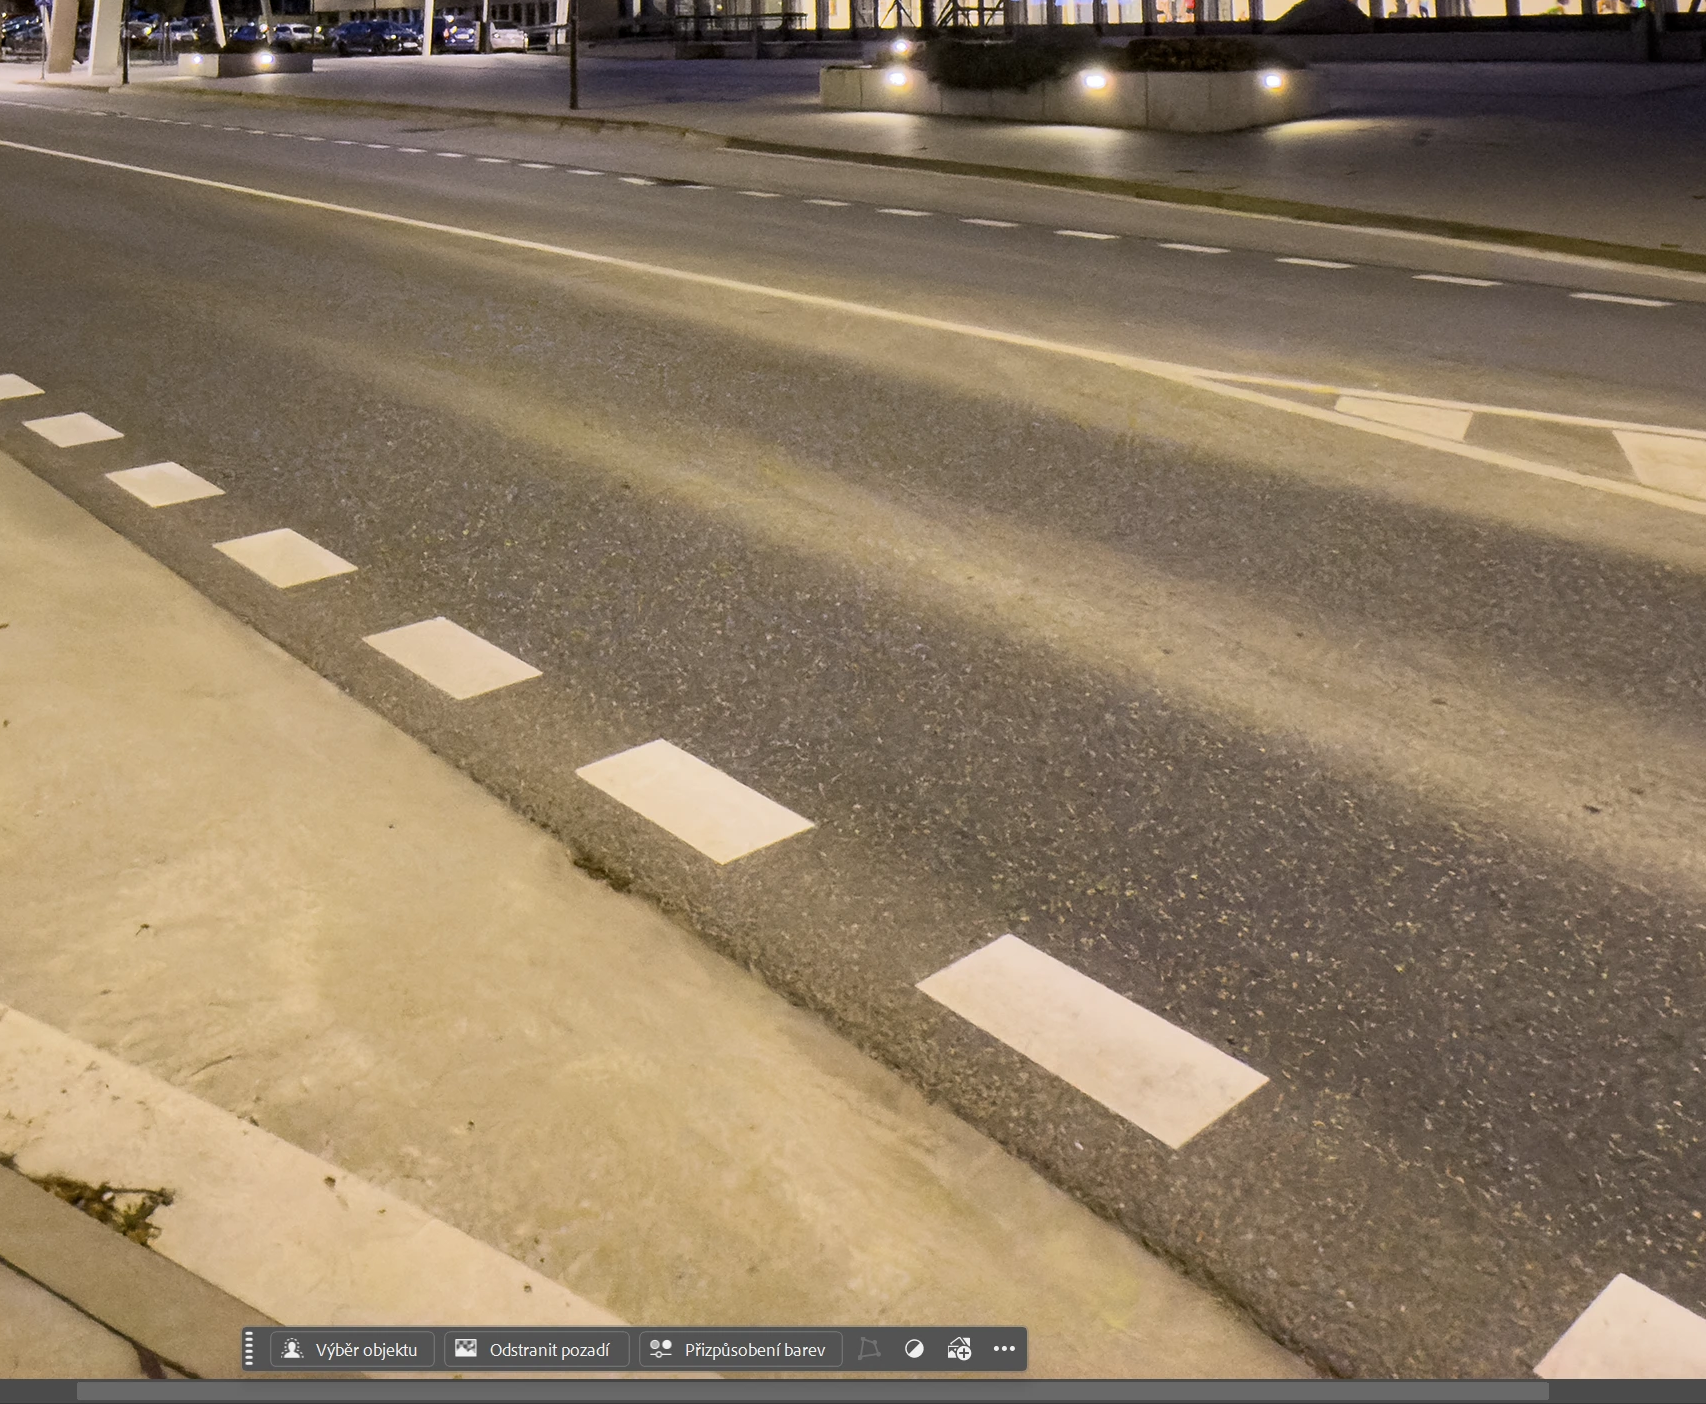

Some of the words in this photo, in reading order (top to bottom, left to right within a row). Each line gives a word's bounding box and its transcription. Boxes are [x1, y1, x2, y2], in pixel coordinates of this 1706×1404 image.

[316, 1343, 359, 1360] Výběr
[363, 1343, 417, 1360] objektu
[491, 1343, 557, 1356] Odstranit
[562, 1343, 610, 1360] pozadí
[686, 1343, 781, 1360] Přizpůsobení
[785, 1343, 825, 1356] barev
